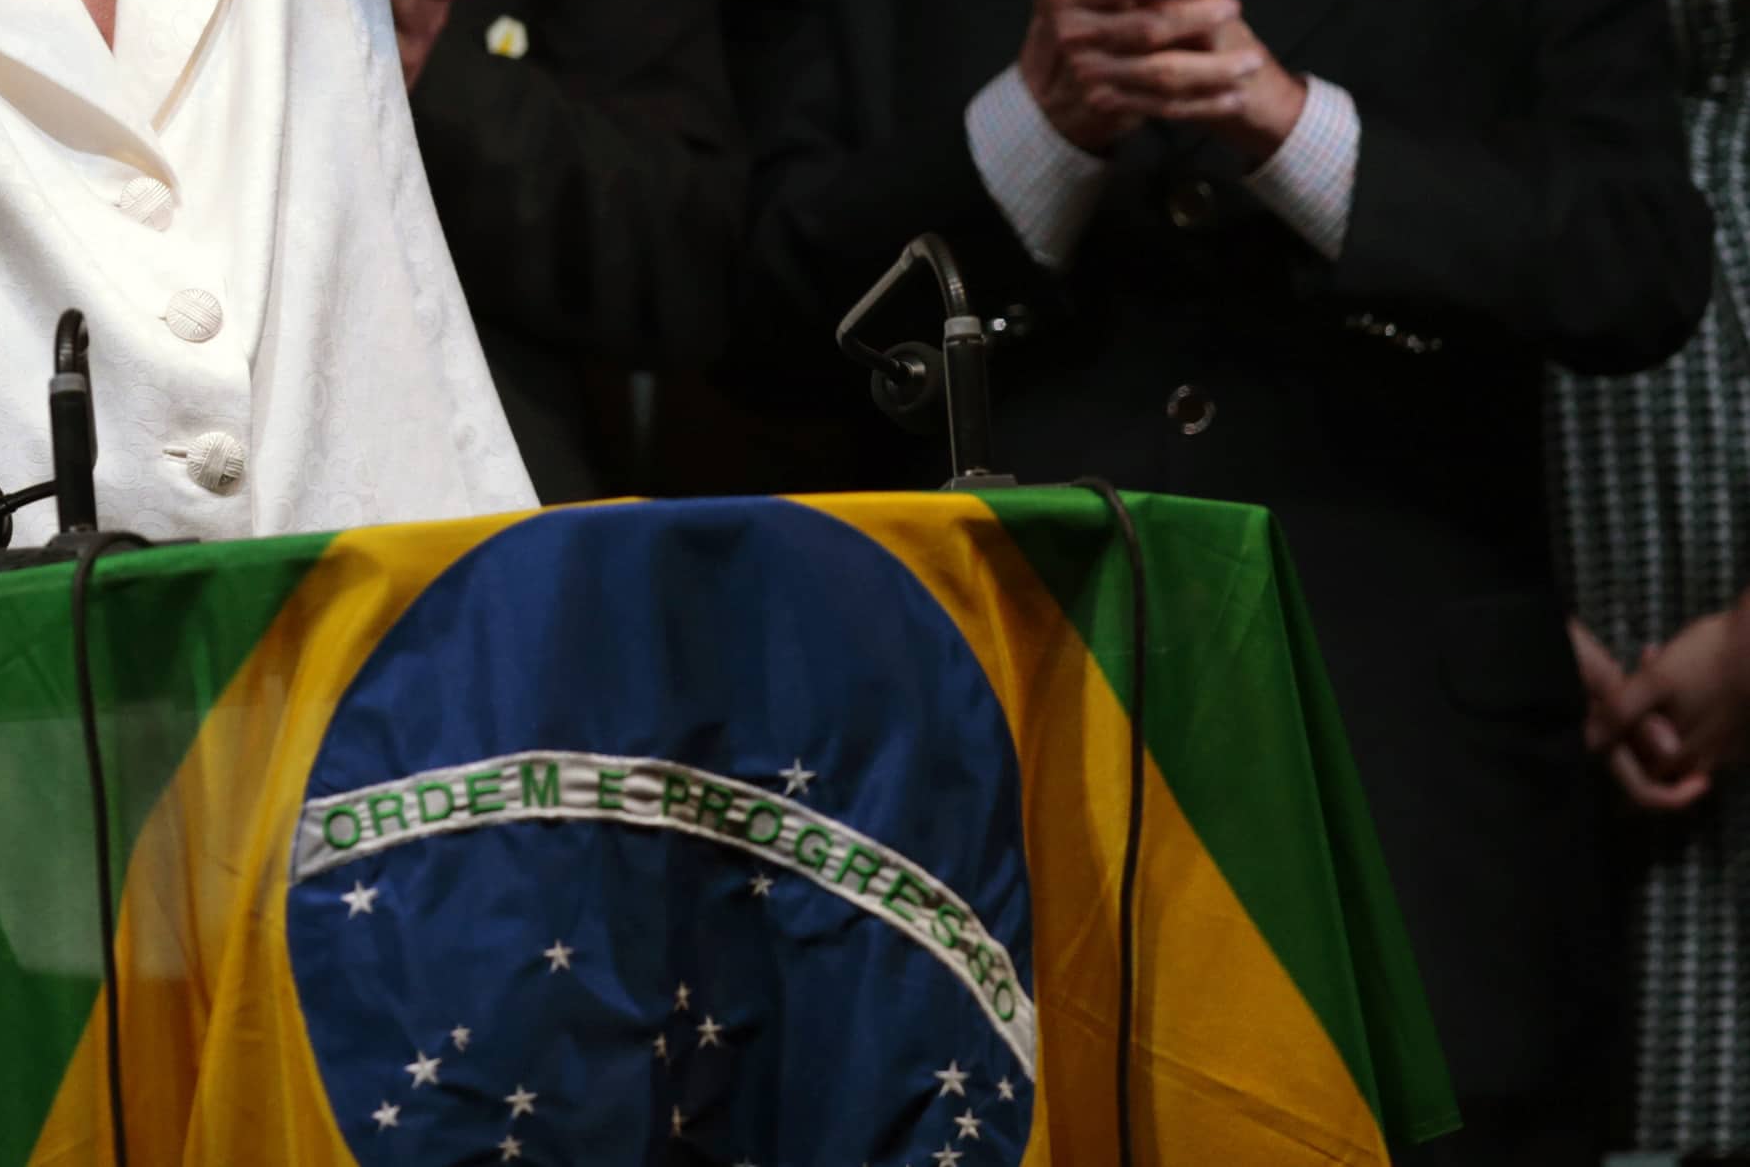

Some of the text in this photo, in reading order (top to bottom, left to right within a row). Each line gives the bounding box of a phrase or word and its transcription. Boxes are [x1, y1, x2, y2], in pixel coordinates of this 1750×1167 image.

[323, 762, 1016, 1023] ORDEM E PROGRESSO
